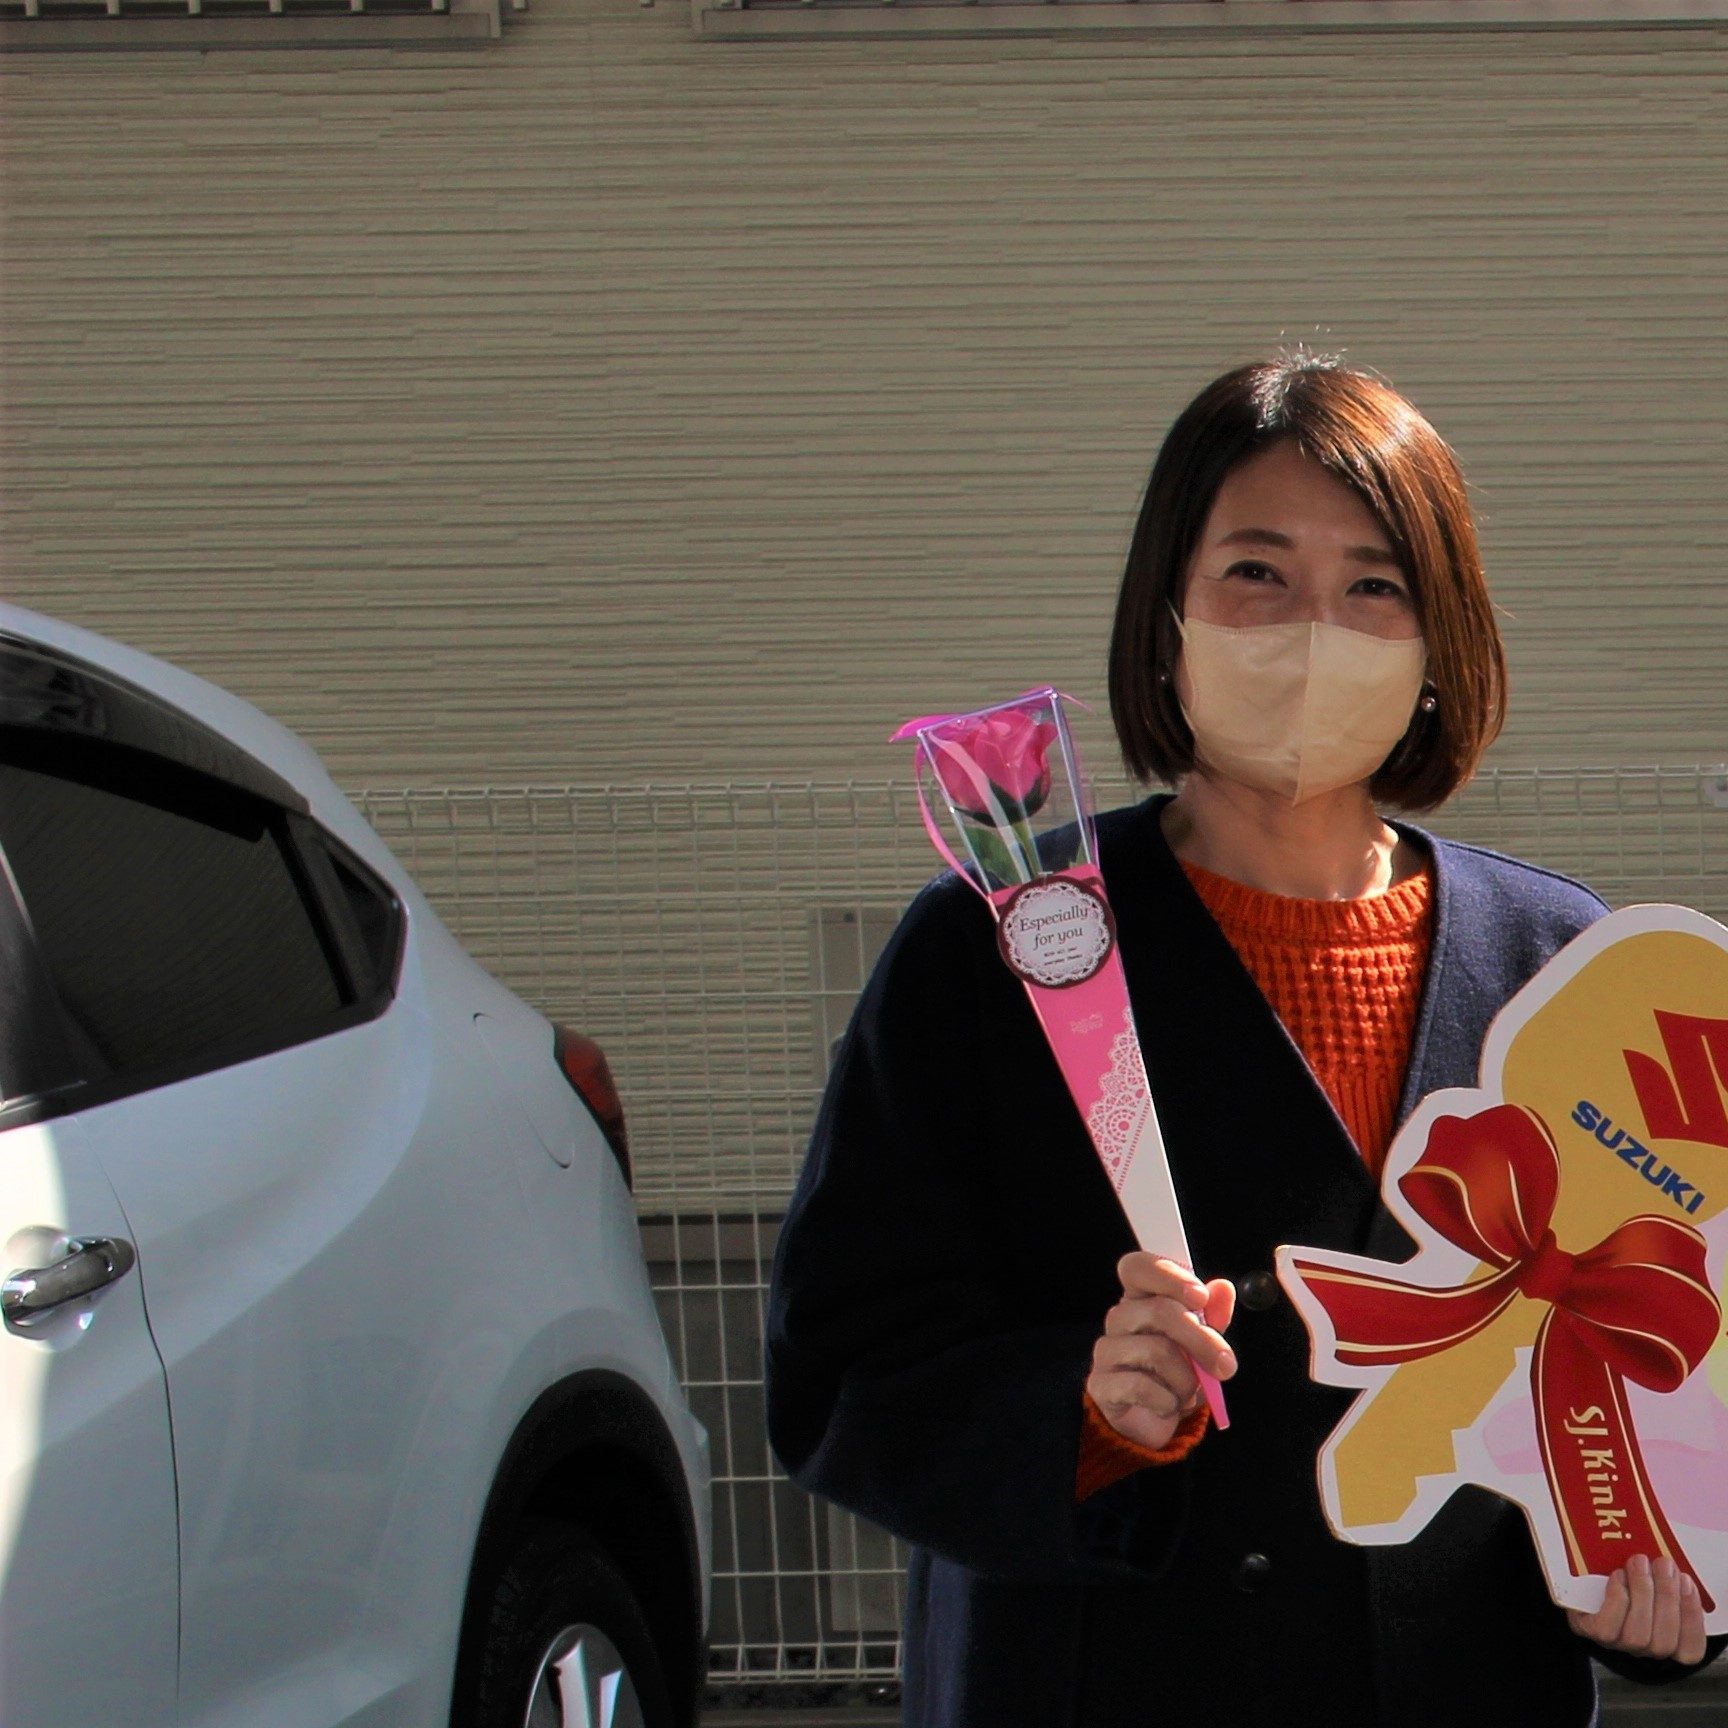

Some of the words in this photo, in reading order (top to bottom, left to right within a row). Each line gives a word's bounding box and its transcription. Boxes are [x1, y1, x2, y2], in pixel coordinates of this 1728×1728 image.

[1020, 905, 1089, 931] Especially
[1033, 932, 1054, 951] for
[1057, 927, 1084, 944] you
[1571, 1100, 1706, 1215] SUZUKI
[1563, 1405, 1632, 1540] SJ.Kinki
